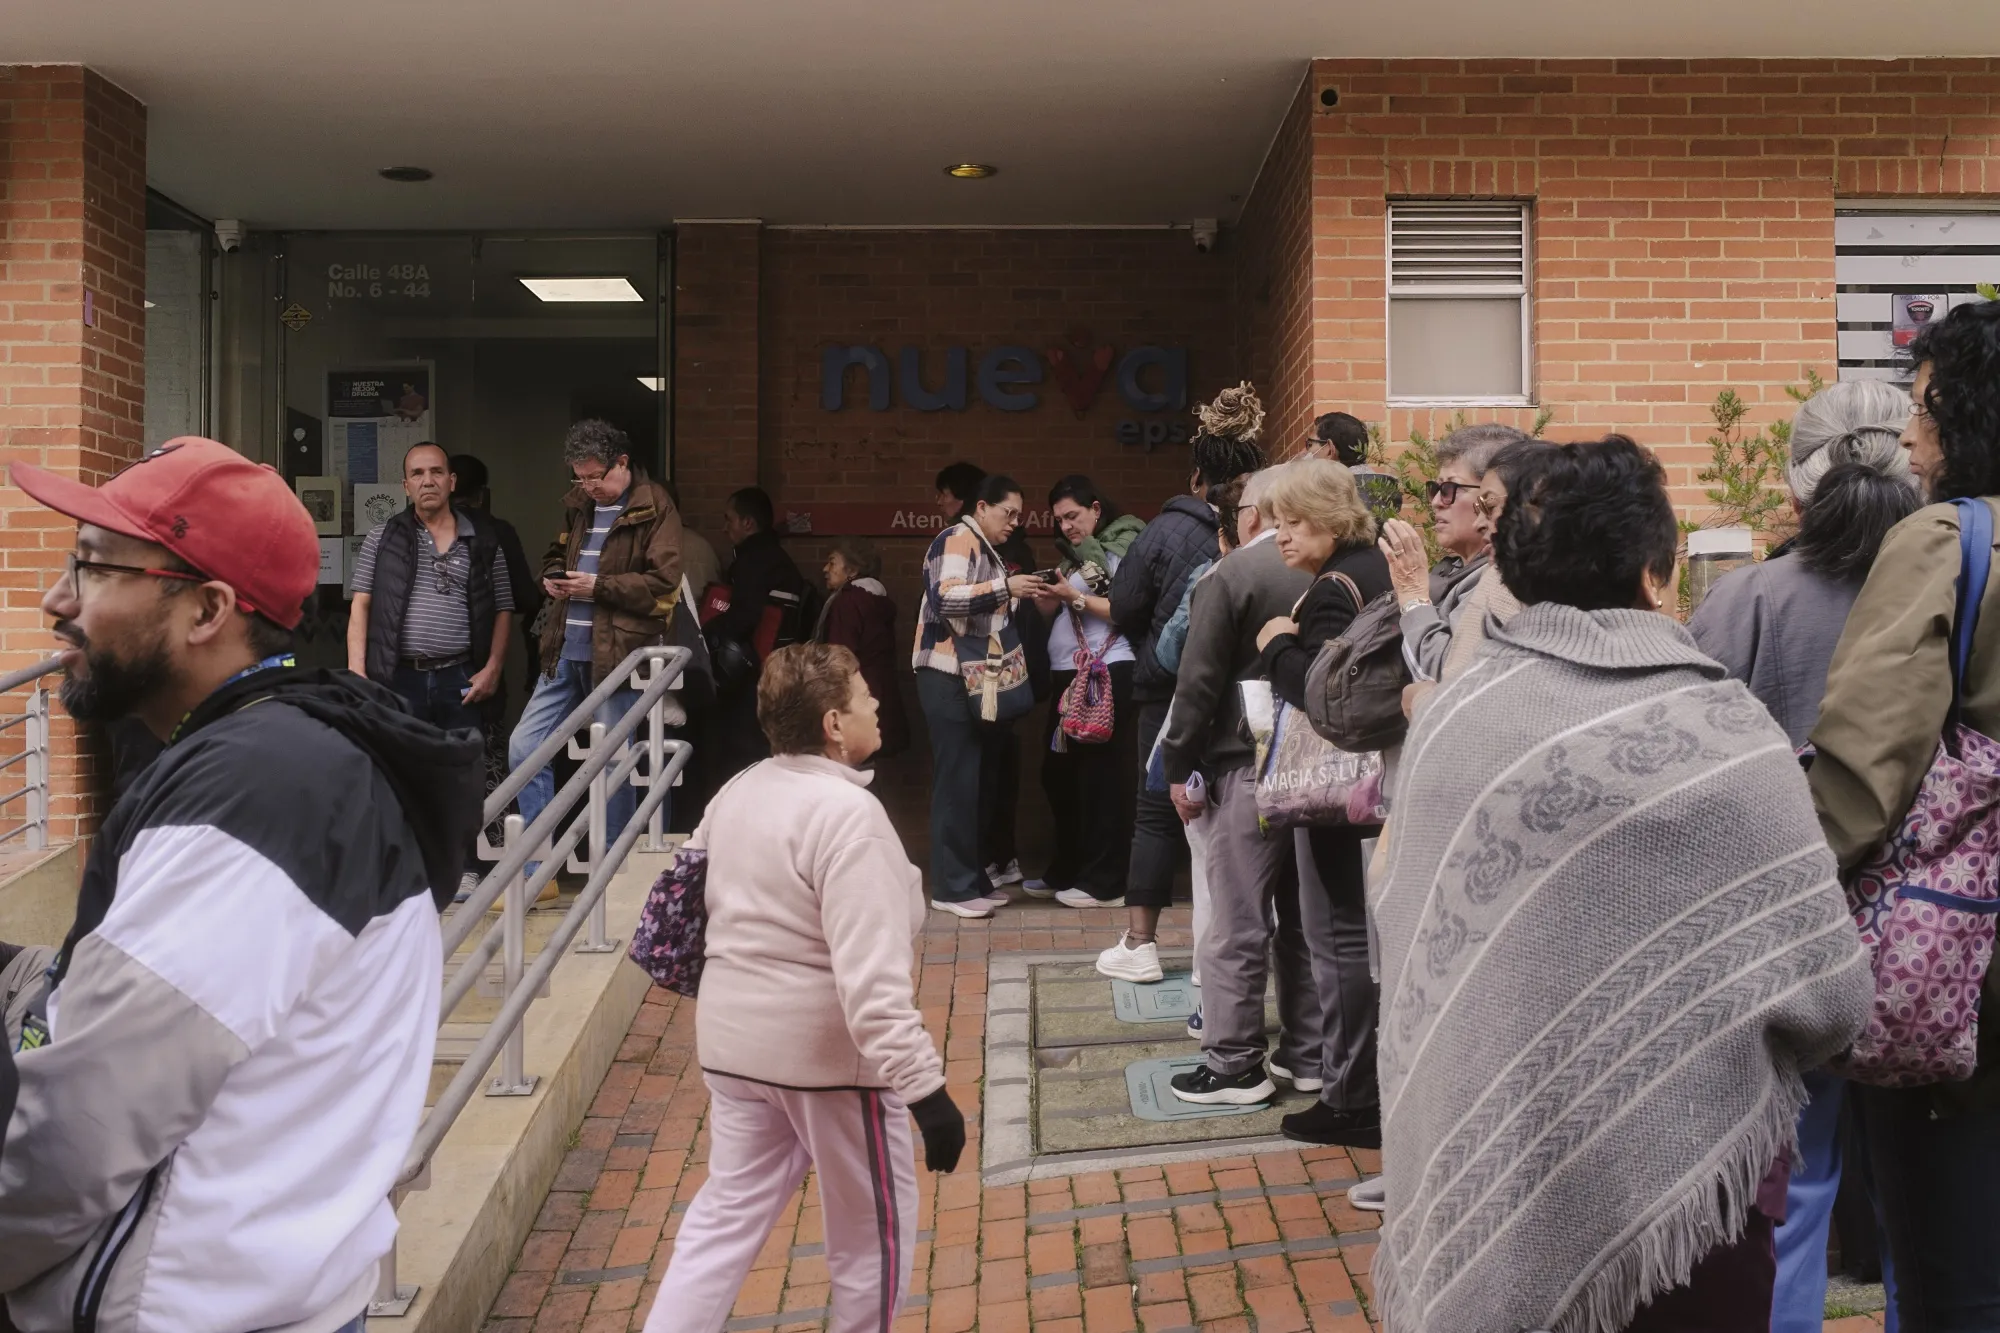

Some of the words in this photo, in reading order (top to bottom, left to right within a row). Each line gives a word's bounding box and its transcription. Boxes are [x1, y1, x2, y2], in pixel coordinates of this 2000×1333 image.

[328, 263, 380, 280] Calle
[387, 264, 430, 280] 48A
[328, 281, 362, 298] No.
[369, 282, 383, 298] 6
[403, 281, 431, 298] 44
[821, 344, 1188, 416] nueva
[1116, 419, 1188, 452] eps
[364, 493, 397, 508] FENASCOL
[1024, 510, 1055, 529] Afi
[1263, 768, 1315, 792] MAGIA
